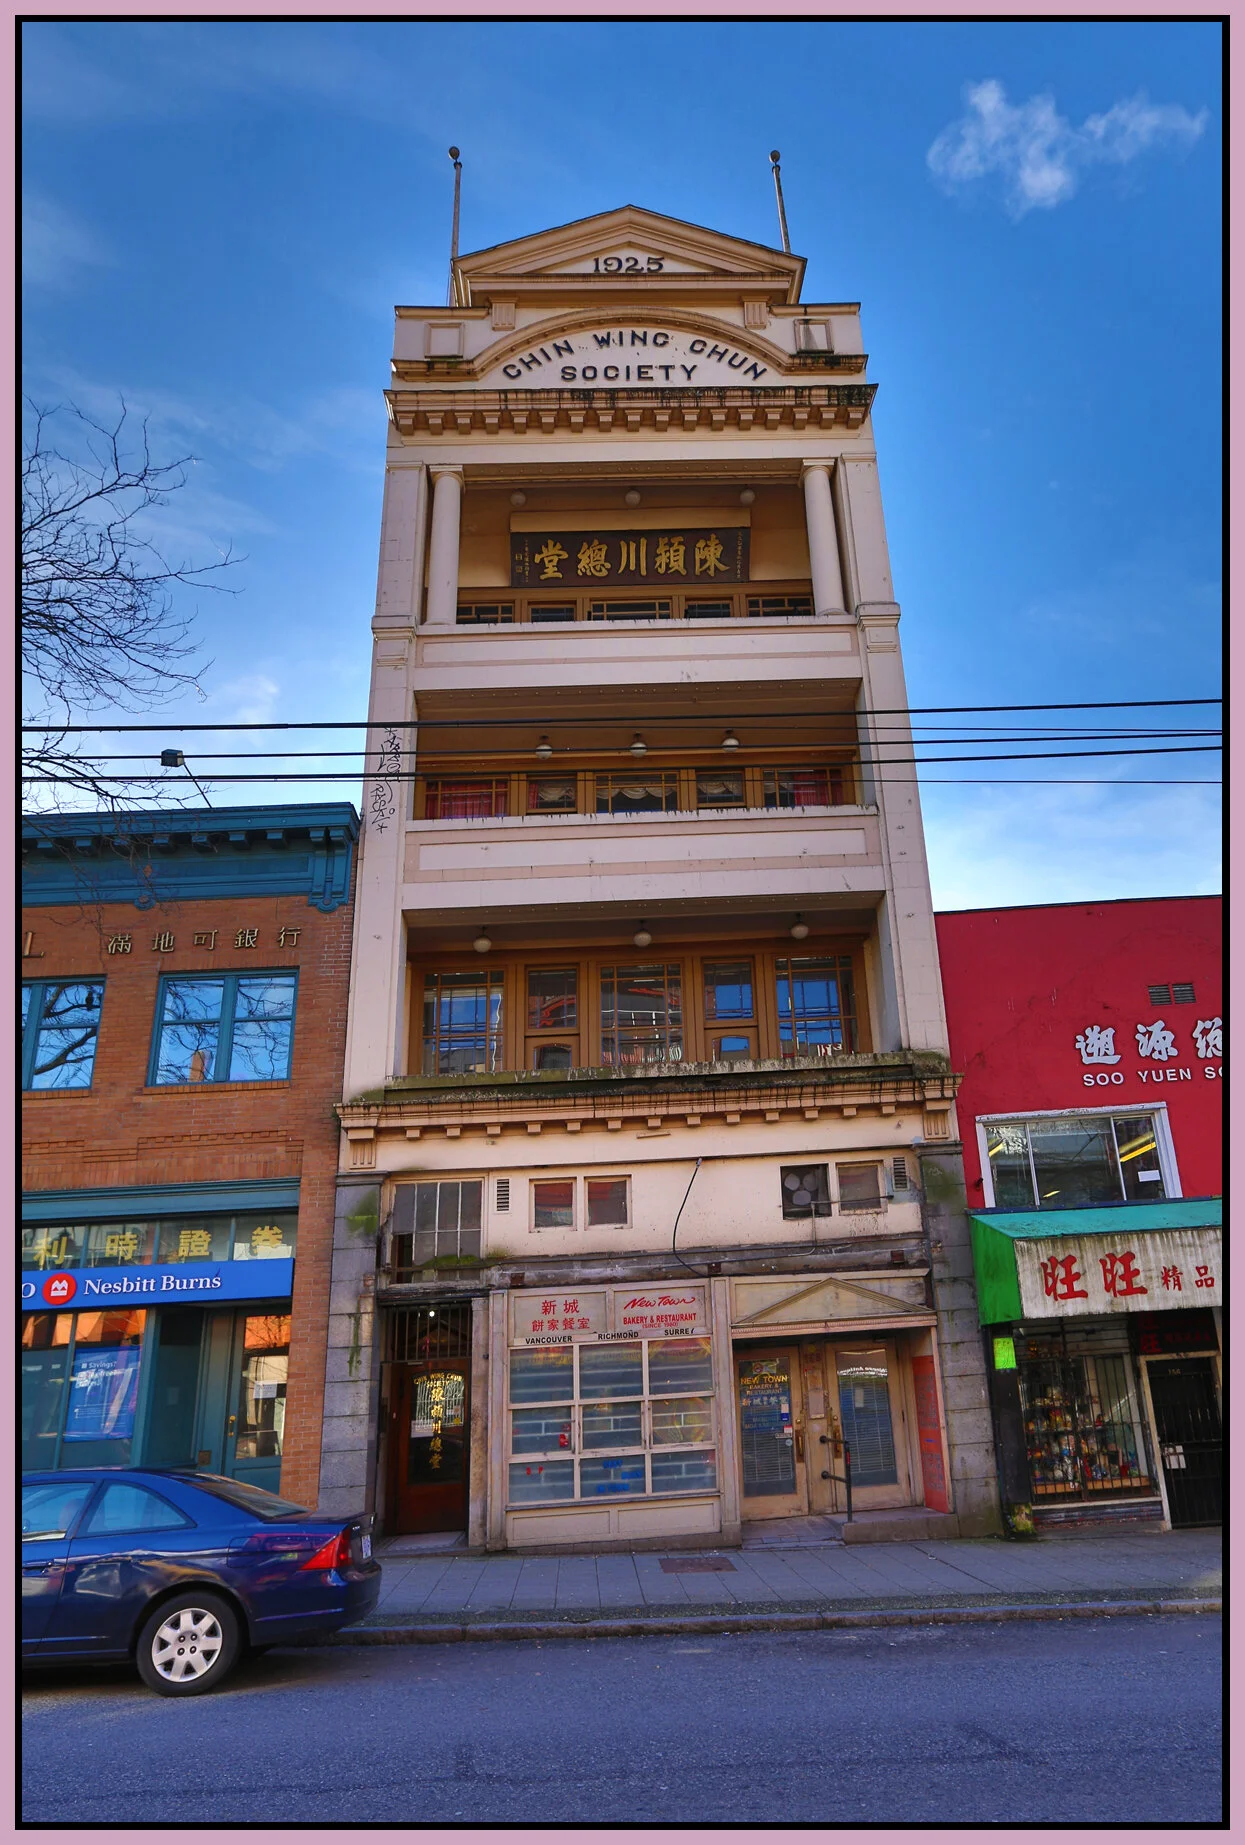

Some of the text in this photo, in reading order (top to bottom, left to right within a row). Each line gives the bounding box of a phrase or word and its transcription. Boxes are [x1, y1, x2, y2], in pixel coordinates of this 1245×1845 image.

[593, 256, 665, 274] 1925
[502, 330, 769, 381] CHIN WING CHUN
[561, 364, 698, 382] SOCIETY
[1082, 1072, 1124, 1087] SOO
[1137, 1067, 1192, 1083] YUEN
[84, 1275, 221, 1295] Nesbitt Burns
[623, 1296, 696, 1310] New Town
[623, 1315, 648, 1325] BAKERY
[656, 1312, 697, 1323] RESTAURANT
[525, 1335, 573, 1345] VANCOUVER
[597, 1331, 639, 1341] RICHMOND
[741, 1375, 788, 1385] NEW TOWN
